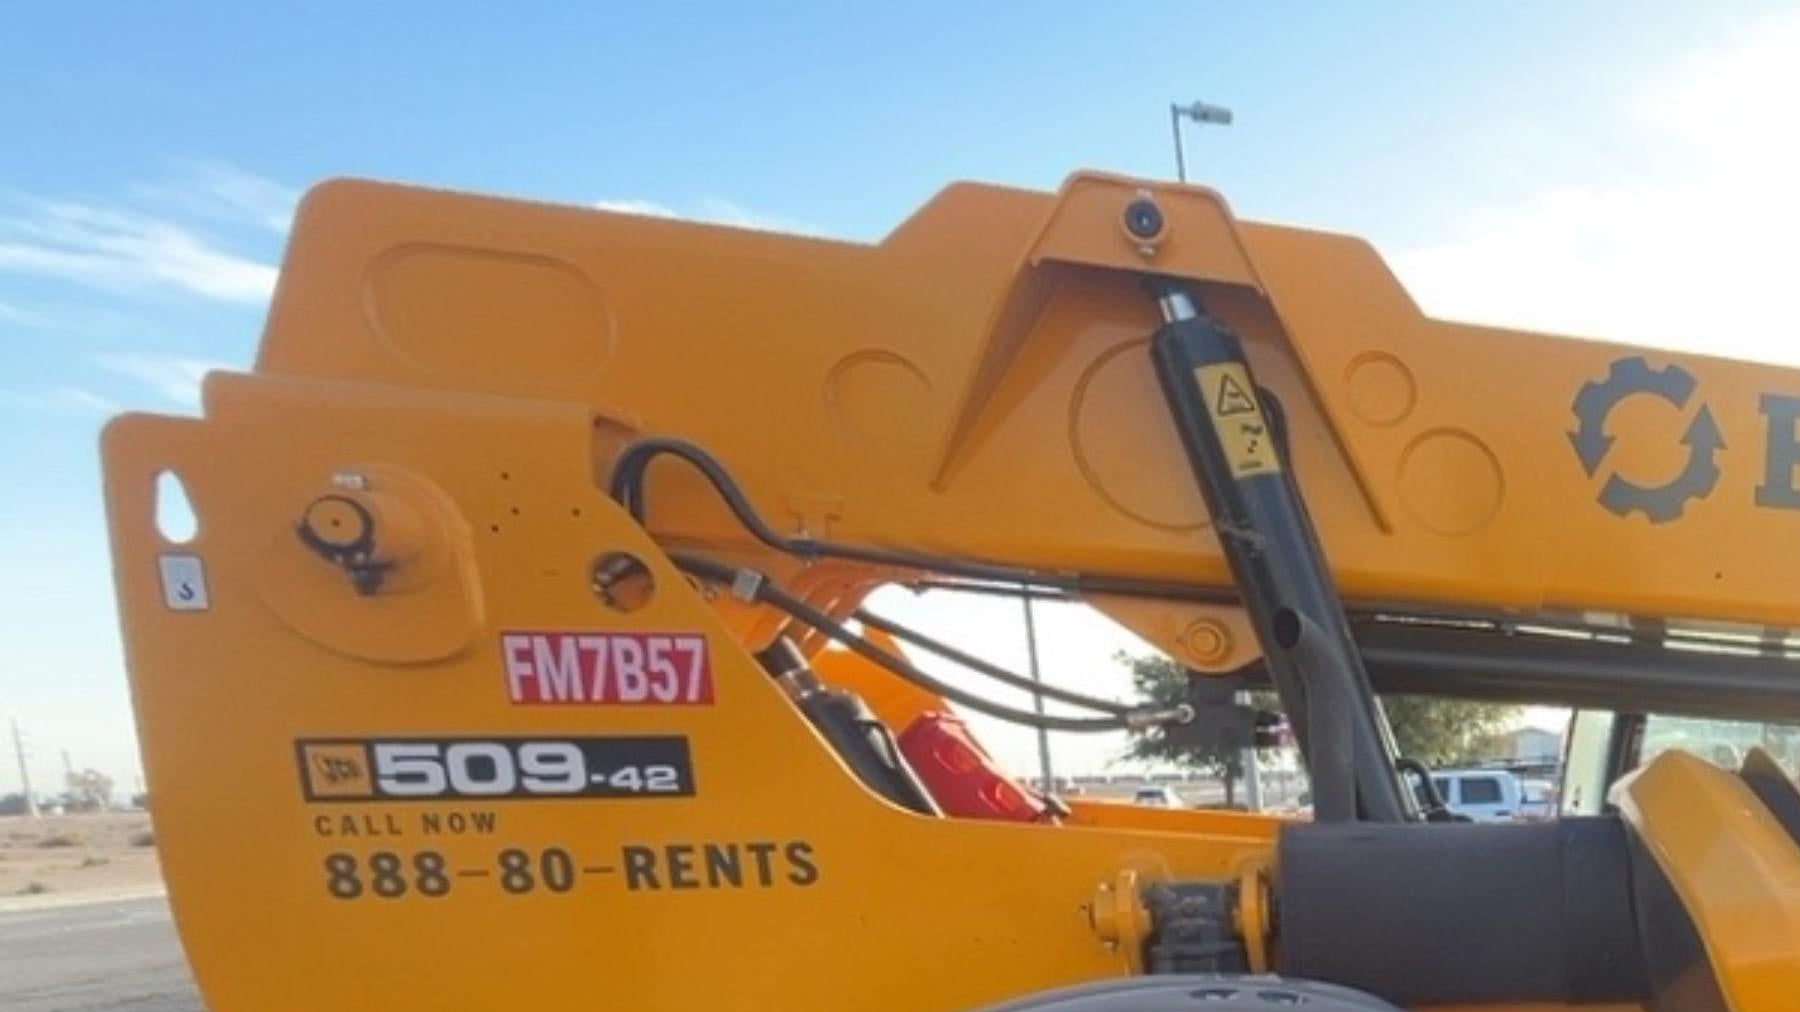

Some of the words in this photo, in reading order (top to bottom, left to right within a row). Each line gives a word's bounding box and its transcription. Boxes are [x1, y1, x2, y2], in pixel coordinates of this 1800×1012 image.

[504, 634, 705, 703] FM7B57
[374, 741, 680, 796] 509-42
[314, 814, 403, 836] CALL
[422, 811, 497, 834] NOW
[325, 841, 820, 899] 888-80-RENTS
